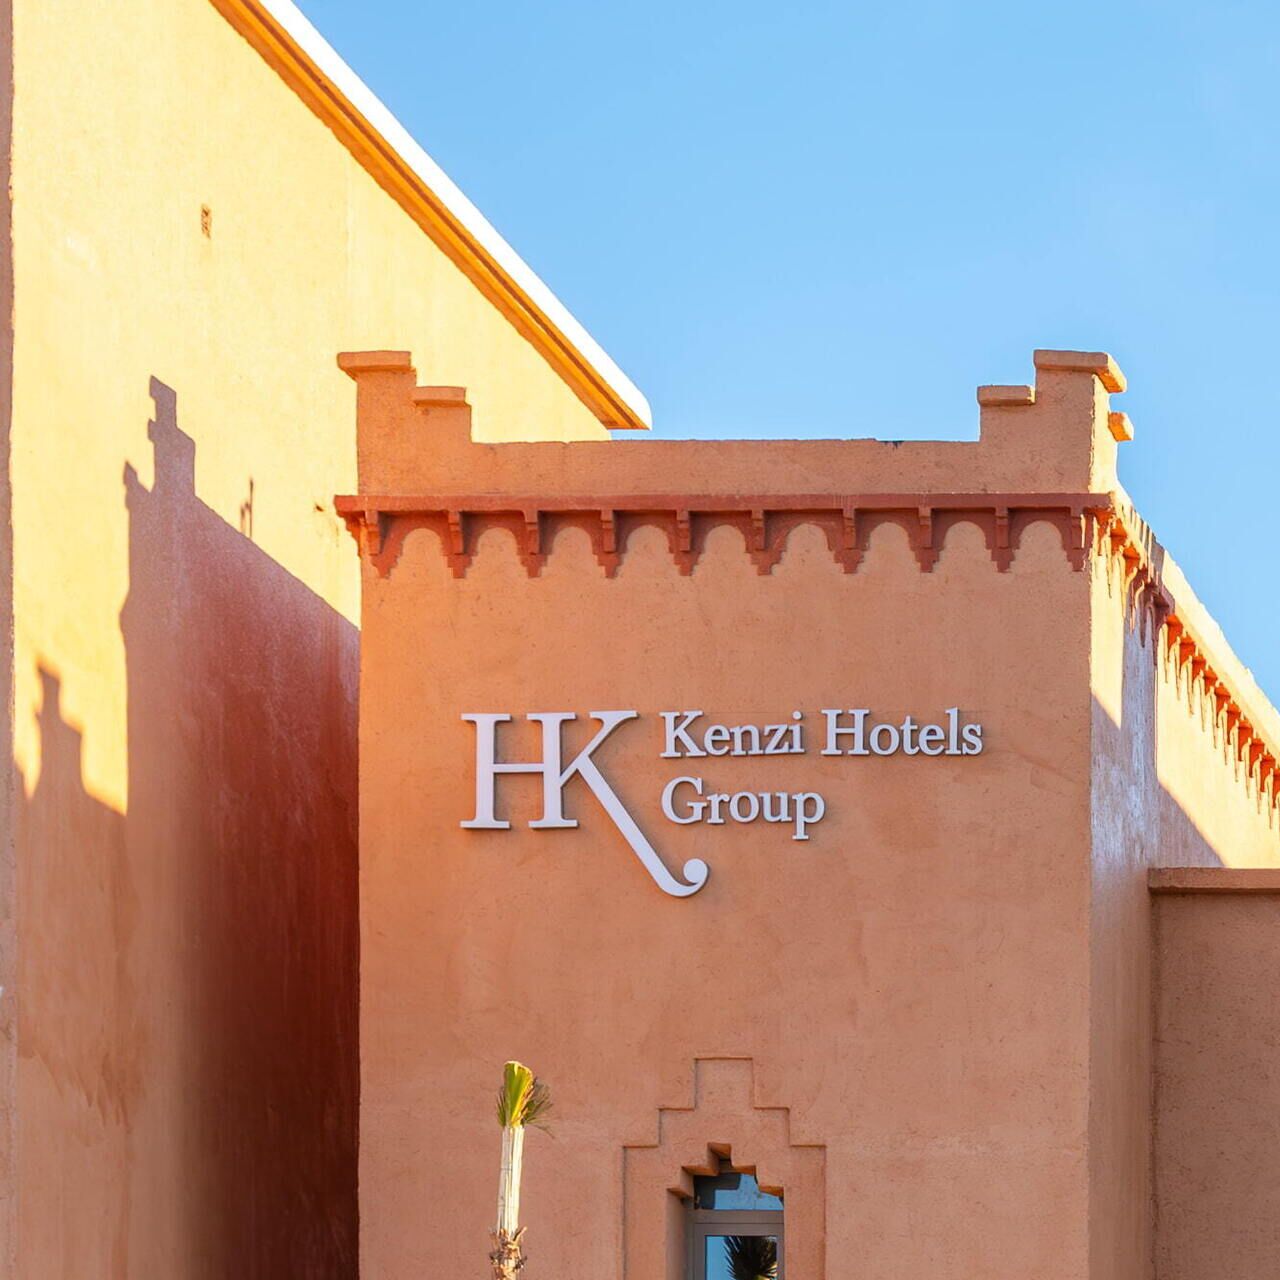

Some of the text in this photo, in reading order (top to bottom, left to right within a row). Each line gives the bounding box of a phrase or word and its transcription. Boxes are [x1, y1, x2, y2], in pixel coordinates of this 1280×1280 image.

[660, 707, 983, 758] Kenzi Hotels
[460, 709, 709, 897] HK
[660, 775, 826, 841] Group
